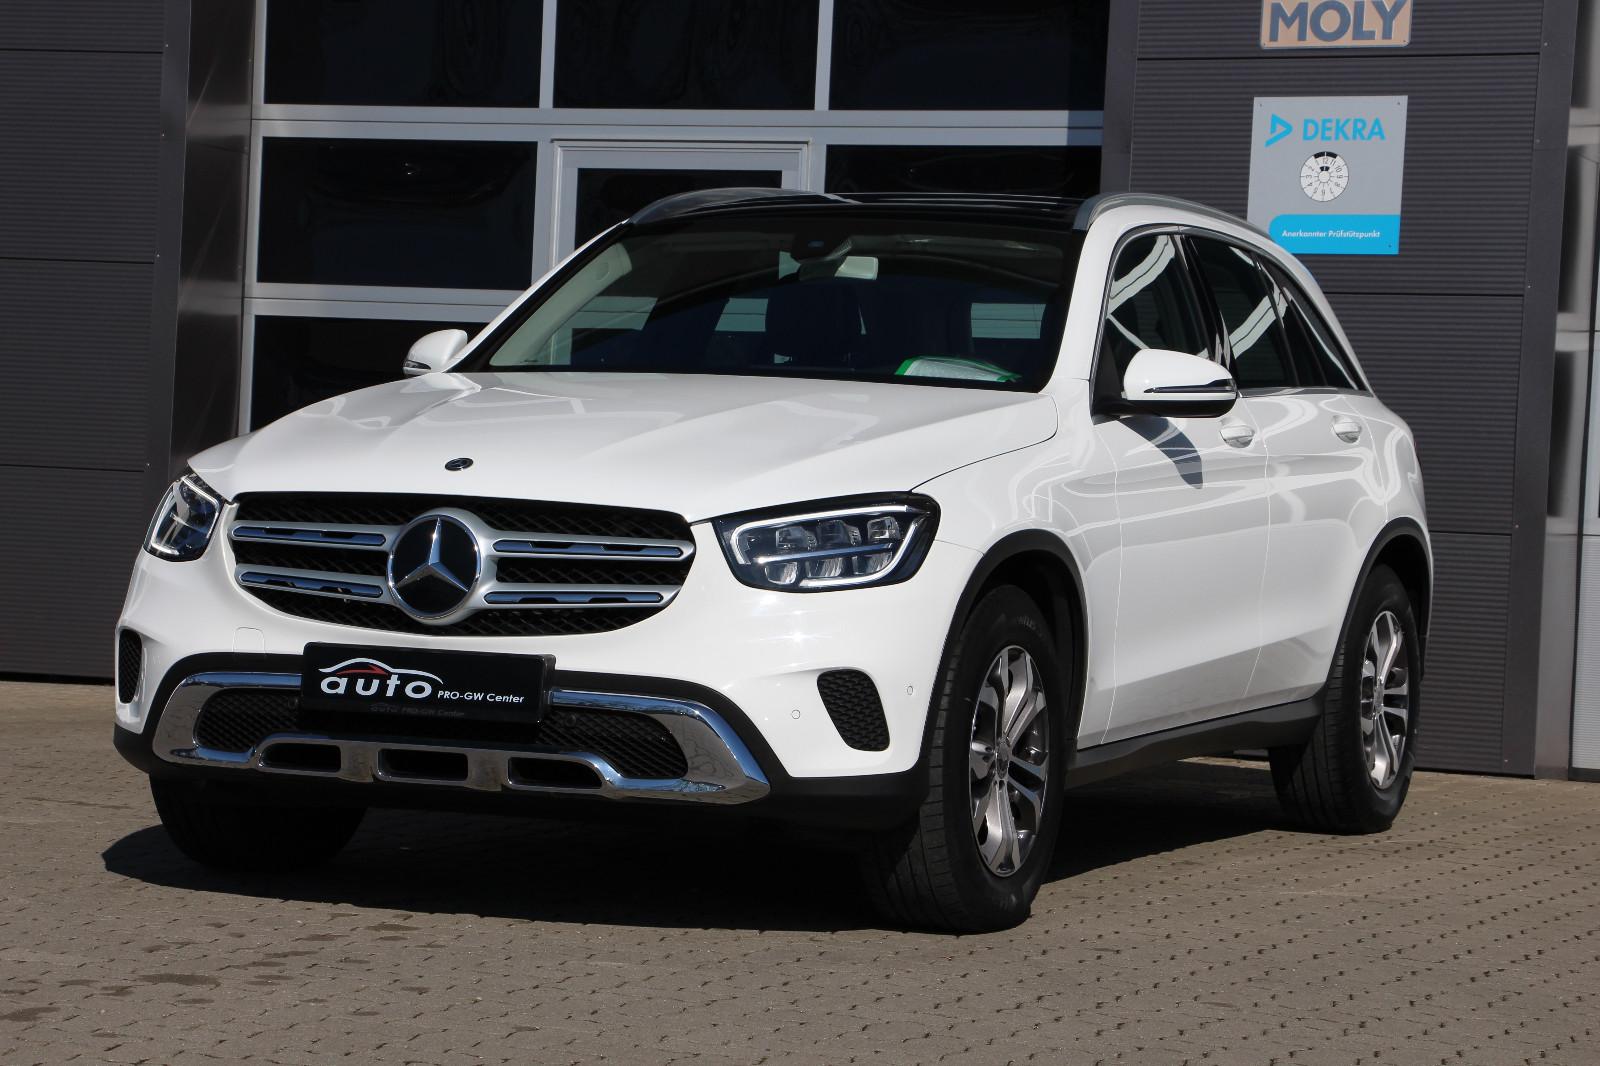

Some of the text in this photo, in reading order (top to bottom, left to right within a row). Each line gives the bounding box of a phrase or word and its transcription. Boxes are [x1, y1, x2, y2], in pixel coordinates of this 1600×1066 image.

[1269, 0, 1405, 42] MOLY
[1302, 118, 1386, 141] DEKRA
[1282, 229, 1381, 240] Anerkannter Prüfstützpunkt
[320, 673, 525, 703] auto PRO-GW Center
